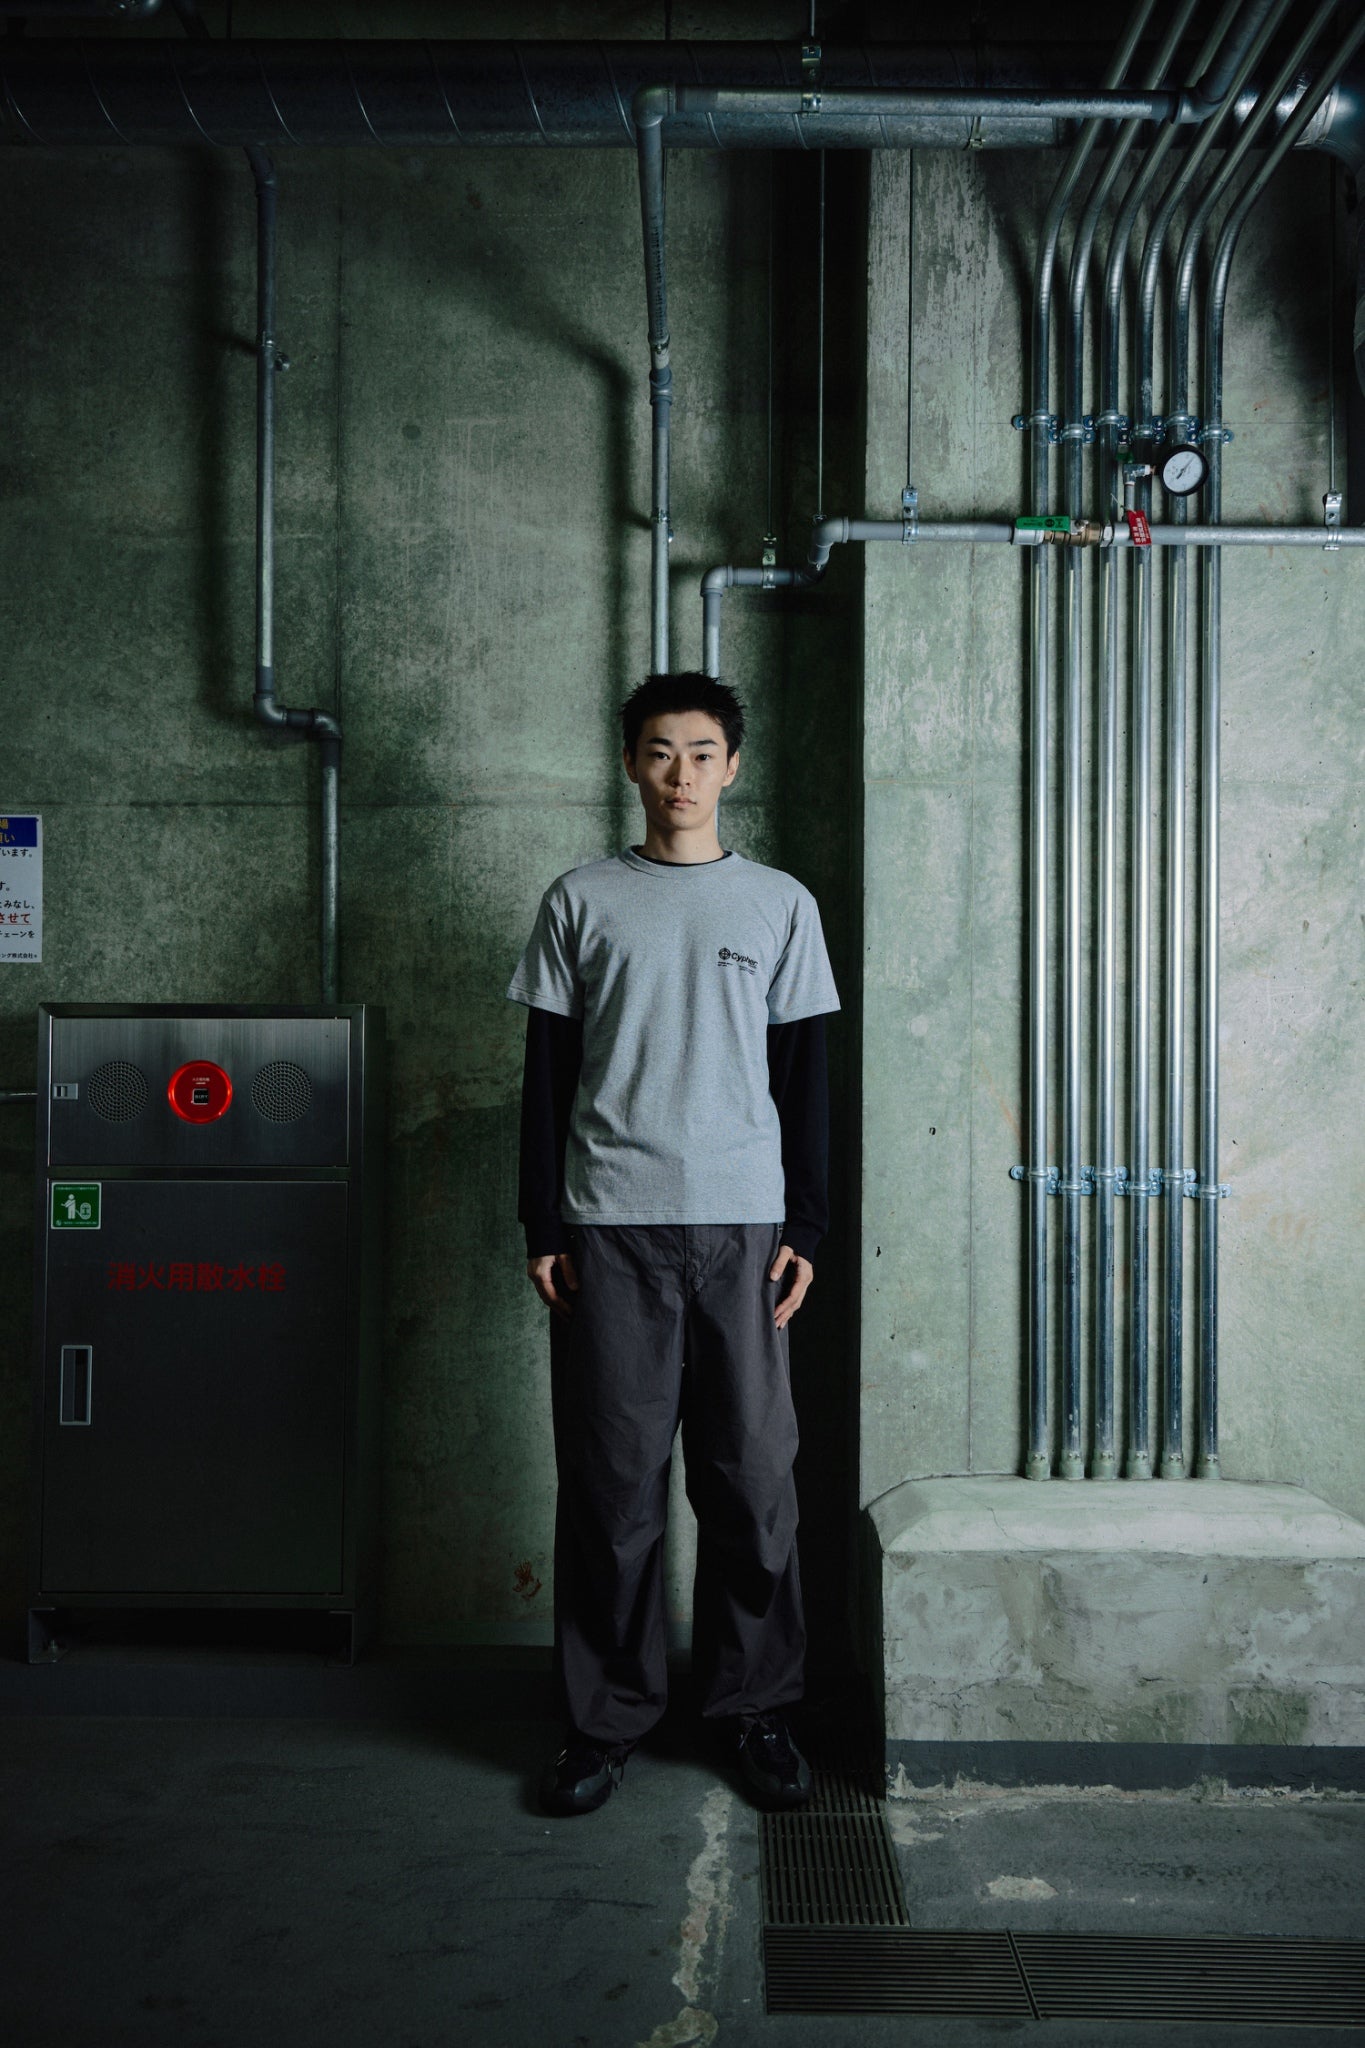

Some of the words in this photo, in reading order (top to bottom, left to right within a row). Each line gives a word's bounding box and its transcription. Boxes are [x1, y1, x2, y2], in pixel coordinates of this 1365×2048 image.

[0, 832, 16, 844] い
[0, 848, 32, 858] います。
[0, 900, 35, 909] みなし、
[0, 930, 35, 939] ェーンを
[731, 952, 759, 965] Cypher
[107, 1261, 287, 1292] 消火用散水栓
